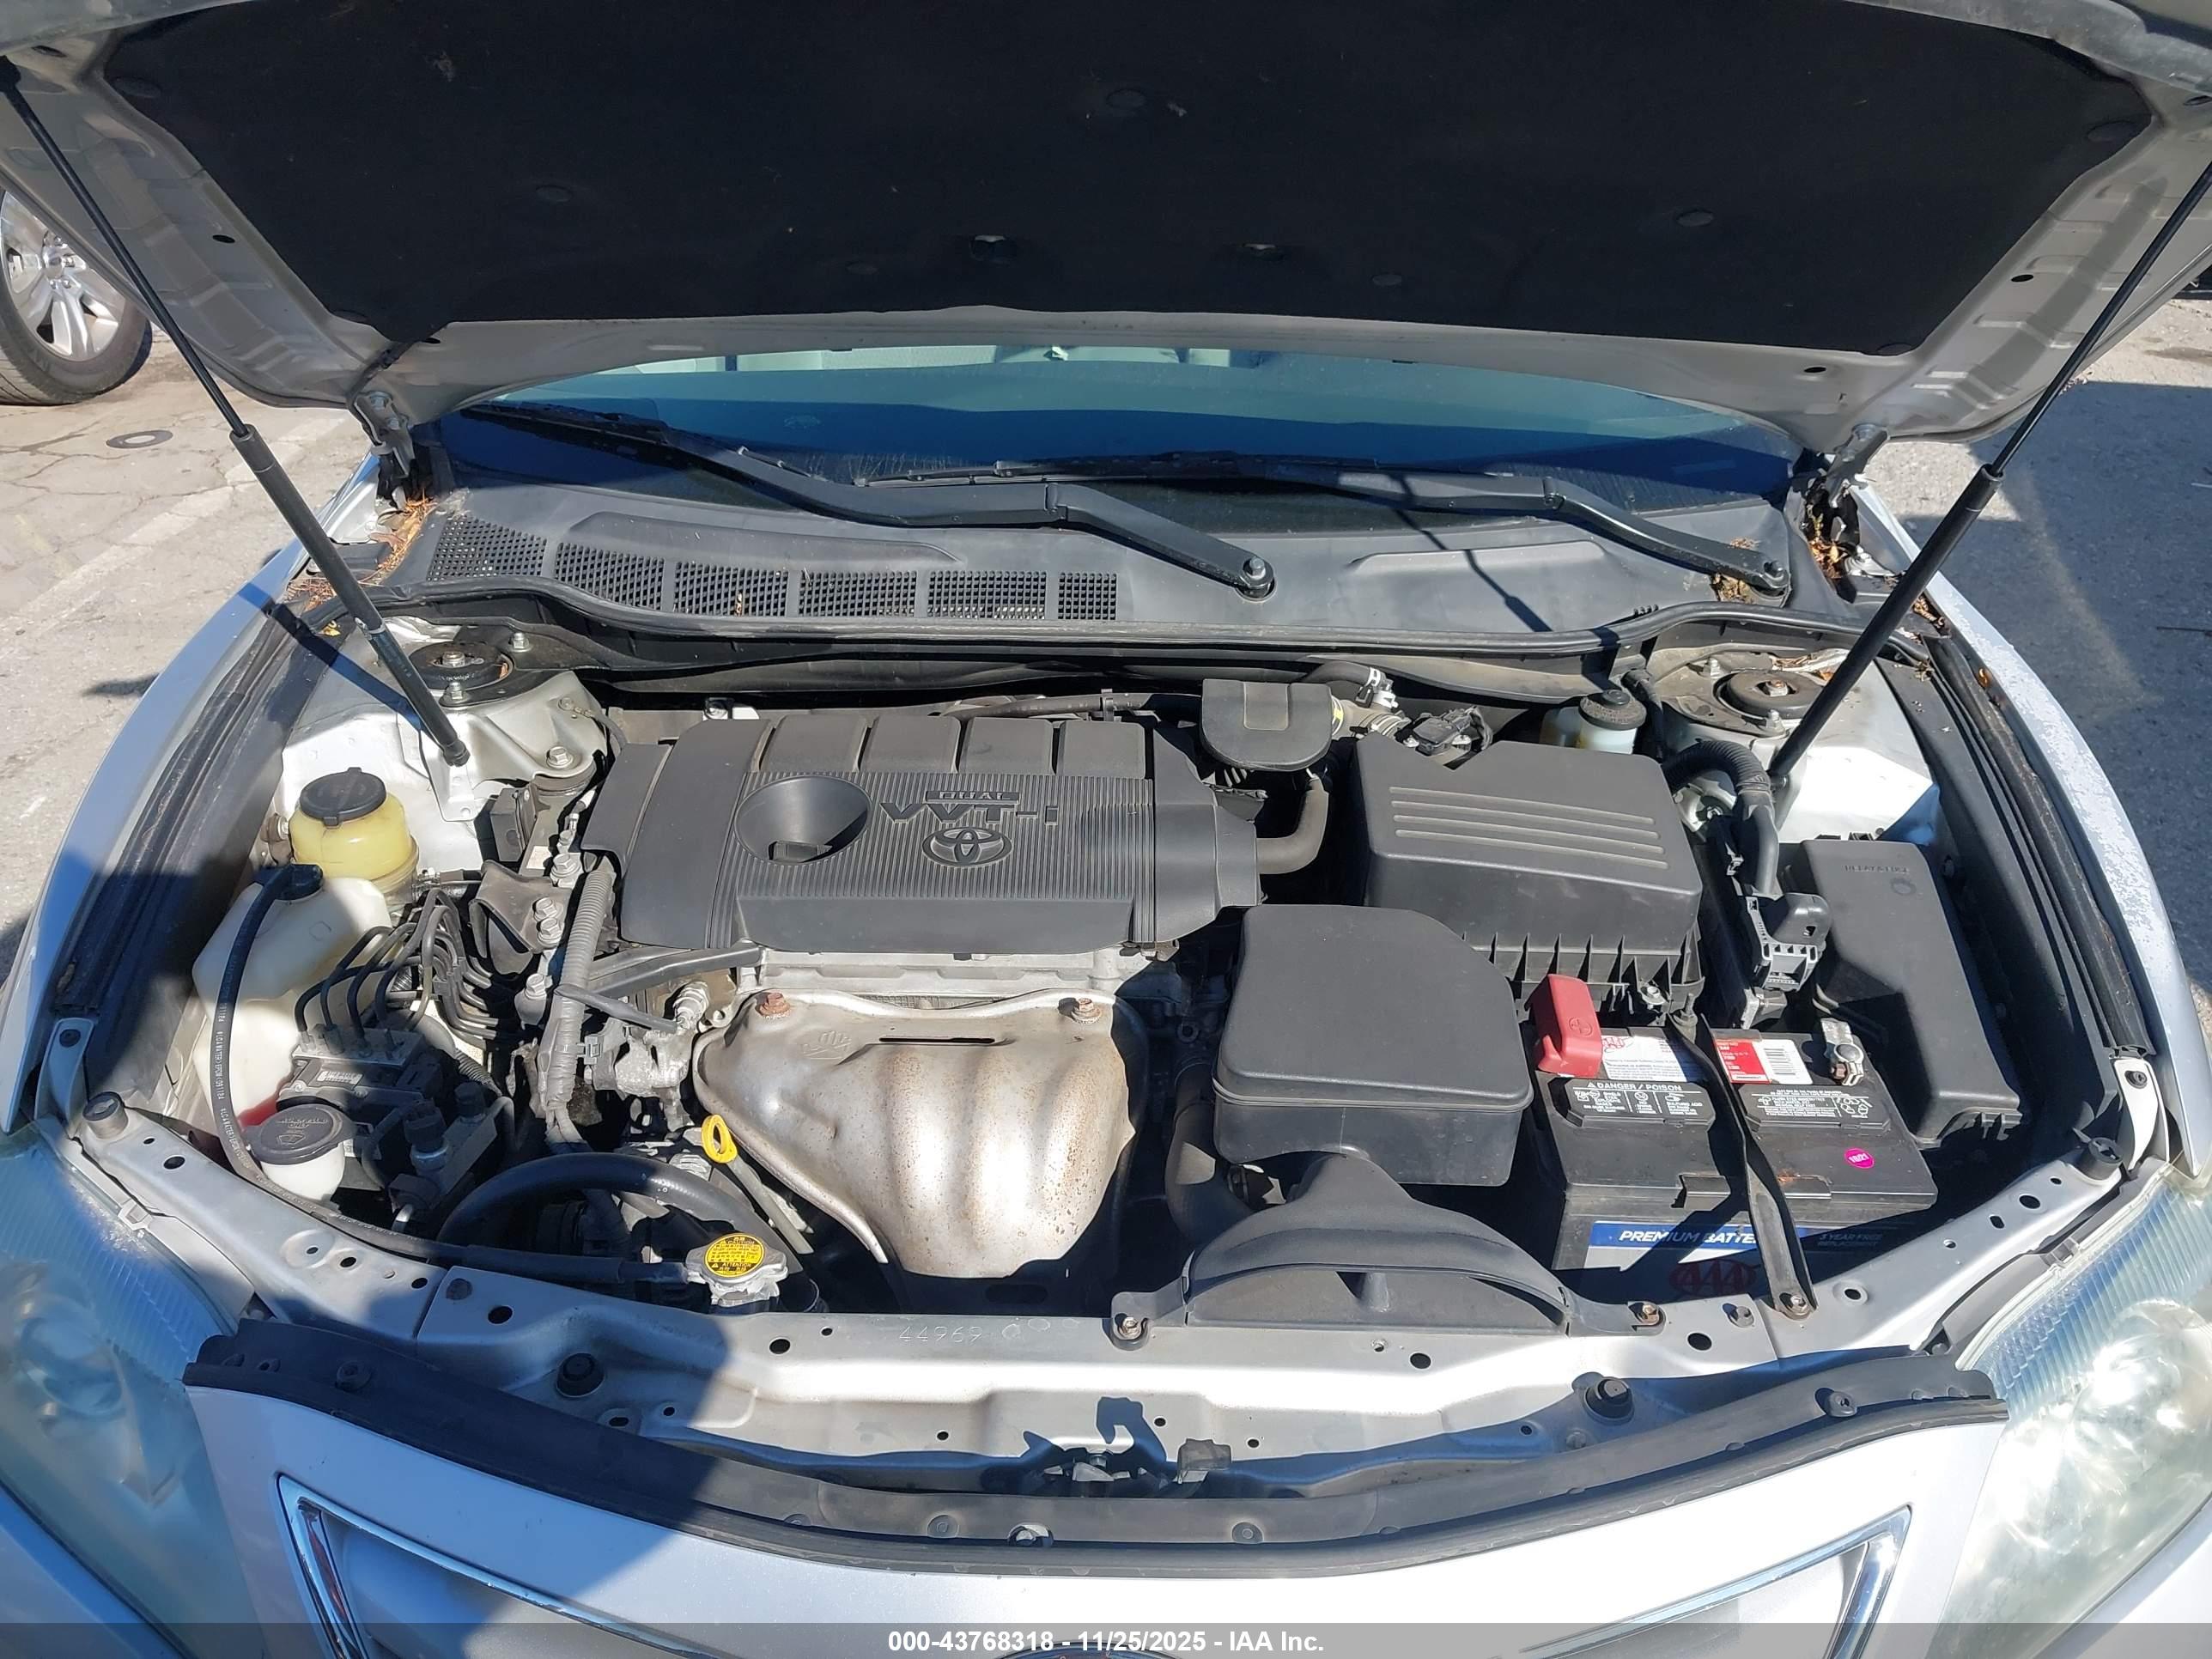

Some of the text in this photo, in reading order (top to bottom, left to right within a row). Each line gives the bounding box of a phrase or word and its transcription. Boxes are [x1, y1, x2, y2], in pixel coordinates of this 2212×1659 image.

[939, 791, 1012, 800] DUAL
[1619, 1230, 1700, 1243] PREMIUM
[899, 1326, 982, 1343] 44969
